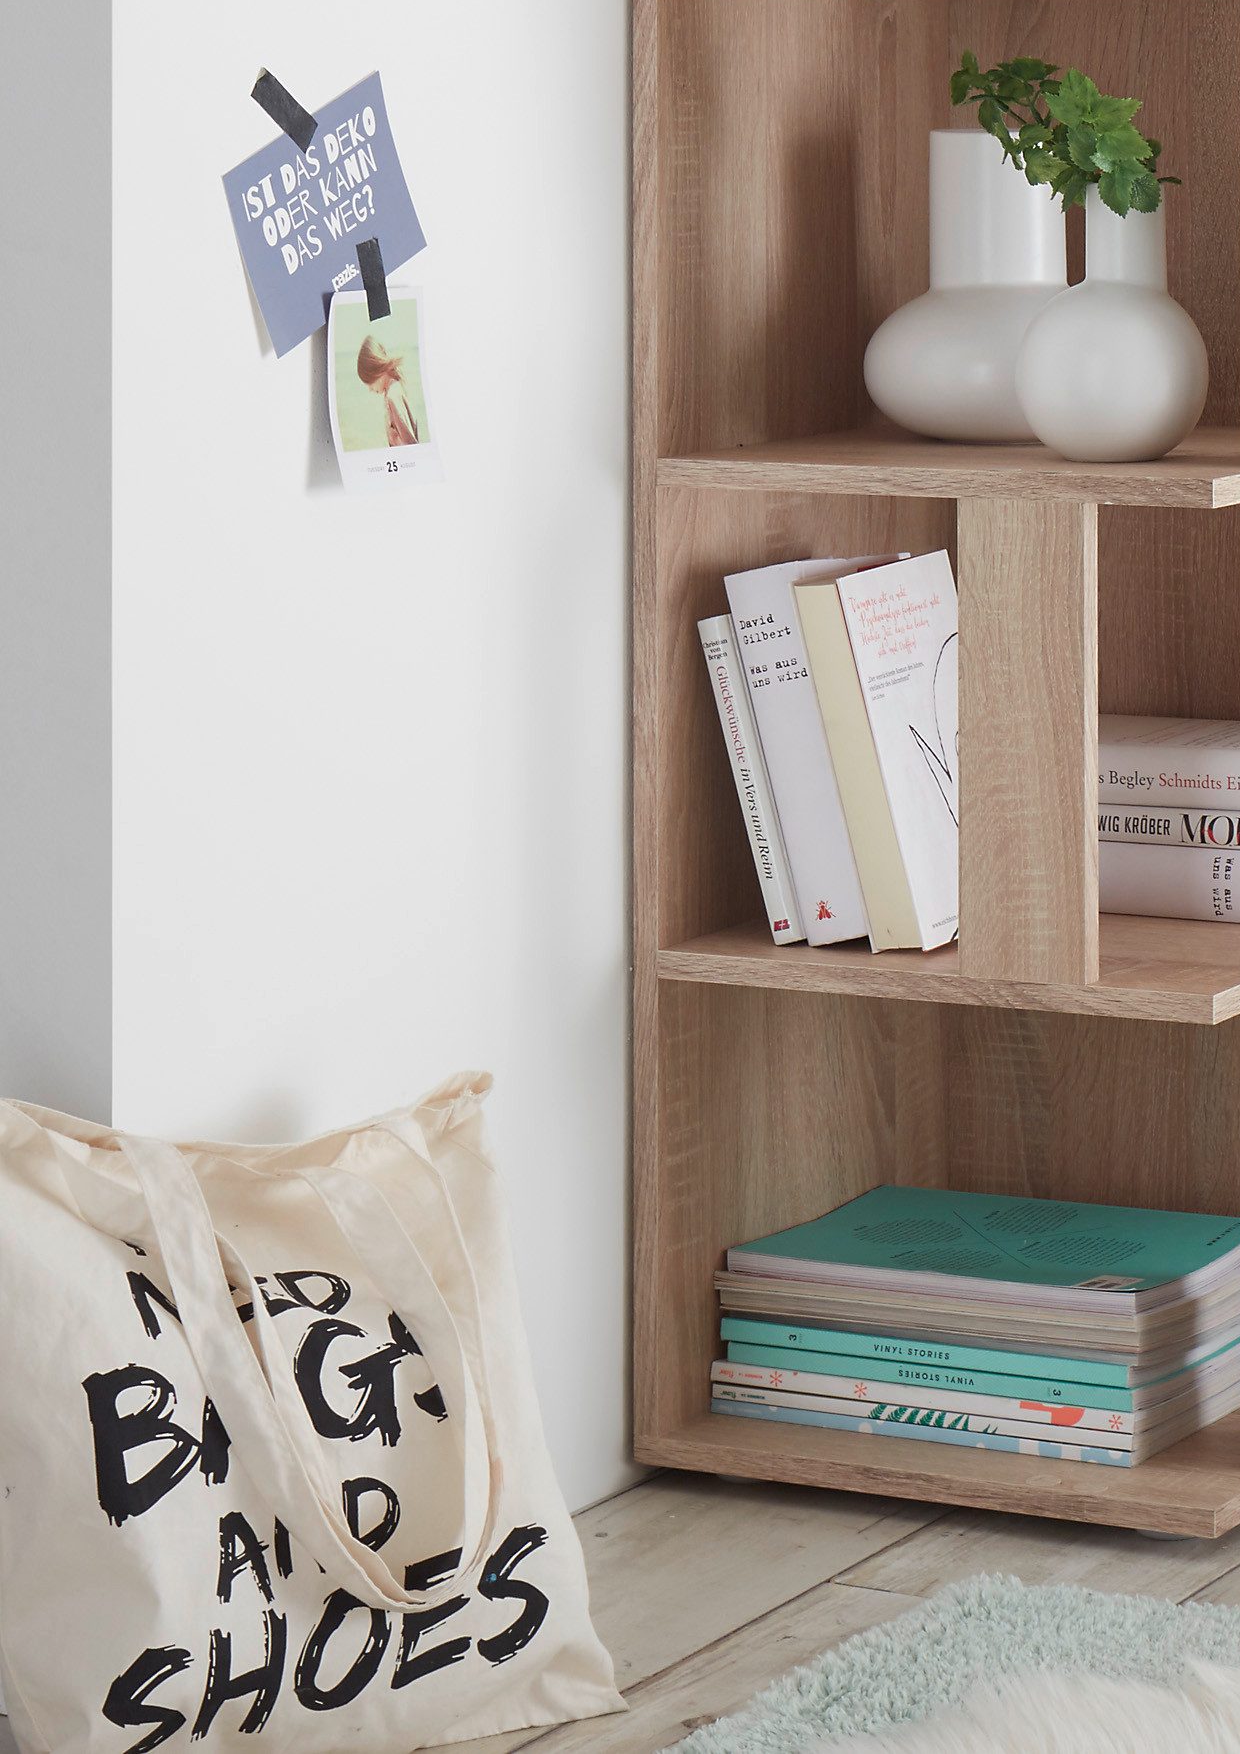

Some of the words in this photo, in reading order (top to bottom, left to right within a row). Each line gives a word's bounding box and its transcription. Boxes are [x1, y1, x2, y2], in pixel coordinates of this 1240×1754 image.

[242, 173, 274, 223] IST
[281, 146, 321, 195] DAS
[324, 105, 377, 159] DEKO
[262, 189, 319, 248] ODER
[320, 143, 379, 208] KANN
[281, 231, 323, 275] DAS
[324, 184, 377, 241] WEG?
[386, 460, 399, 473] 25
[739, 614, 774, 630] David
[743, 626, 792, 645] Gilbert
[775, 657, 798, 669] aus
[752, 676, 772, 688] uns
[777, 668, 808, 684] wird
[716, 666, 748, 763] Glückwünsche
[740, 768, 751, 782] in
[1109, 771, 1155, 791] Begley
[1158, 773, 1222, 789] Schmidts
[744, 783, 757, 812] Vers
[751, 814, 766, 842] und
[1124, 815, 1171, 835] KRÖBER
[758, 843, 773, 879] Reim
[1213, 856, 1221, 881] uns
[1213, 888, 1224, 917] wird
[873, 1344, 903, 1355] VINYL
[907, 1348, 950, 1360] STORIES
[898, 1369, 940, 1381] STORIES
[945, 1375, 974, 1386] VINYL
[102, 1523, 550, 1754] SHOES
